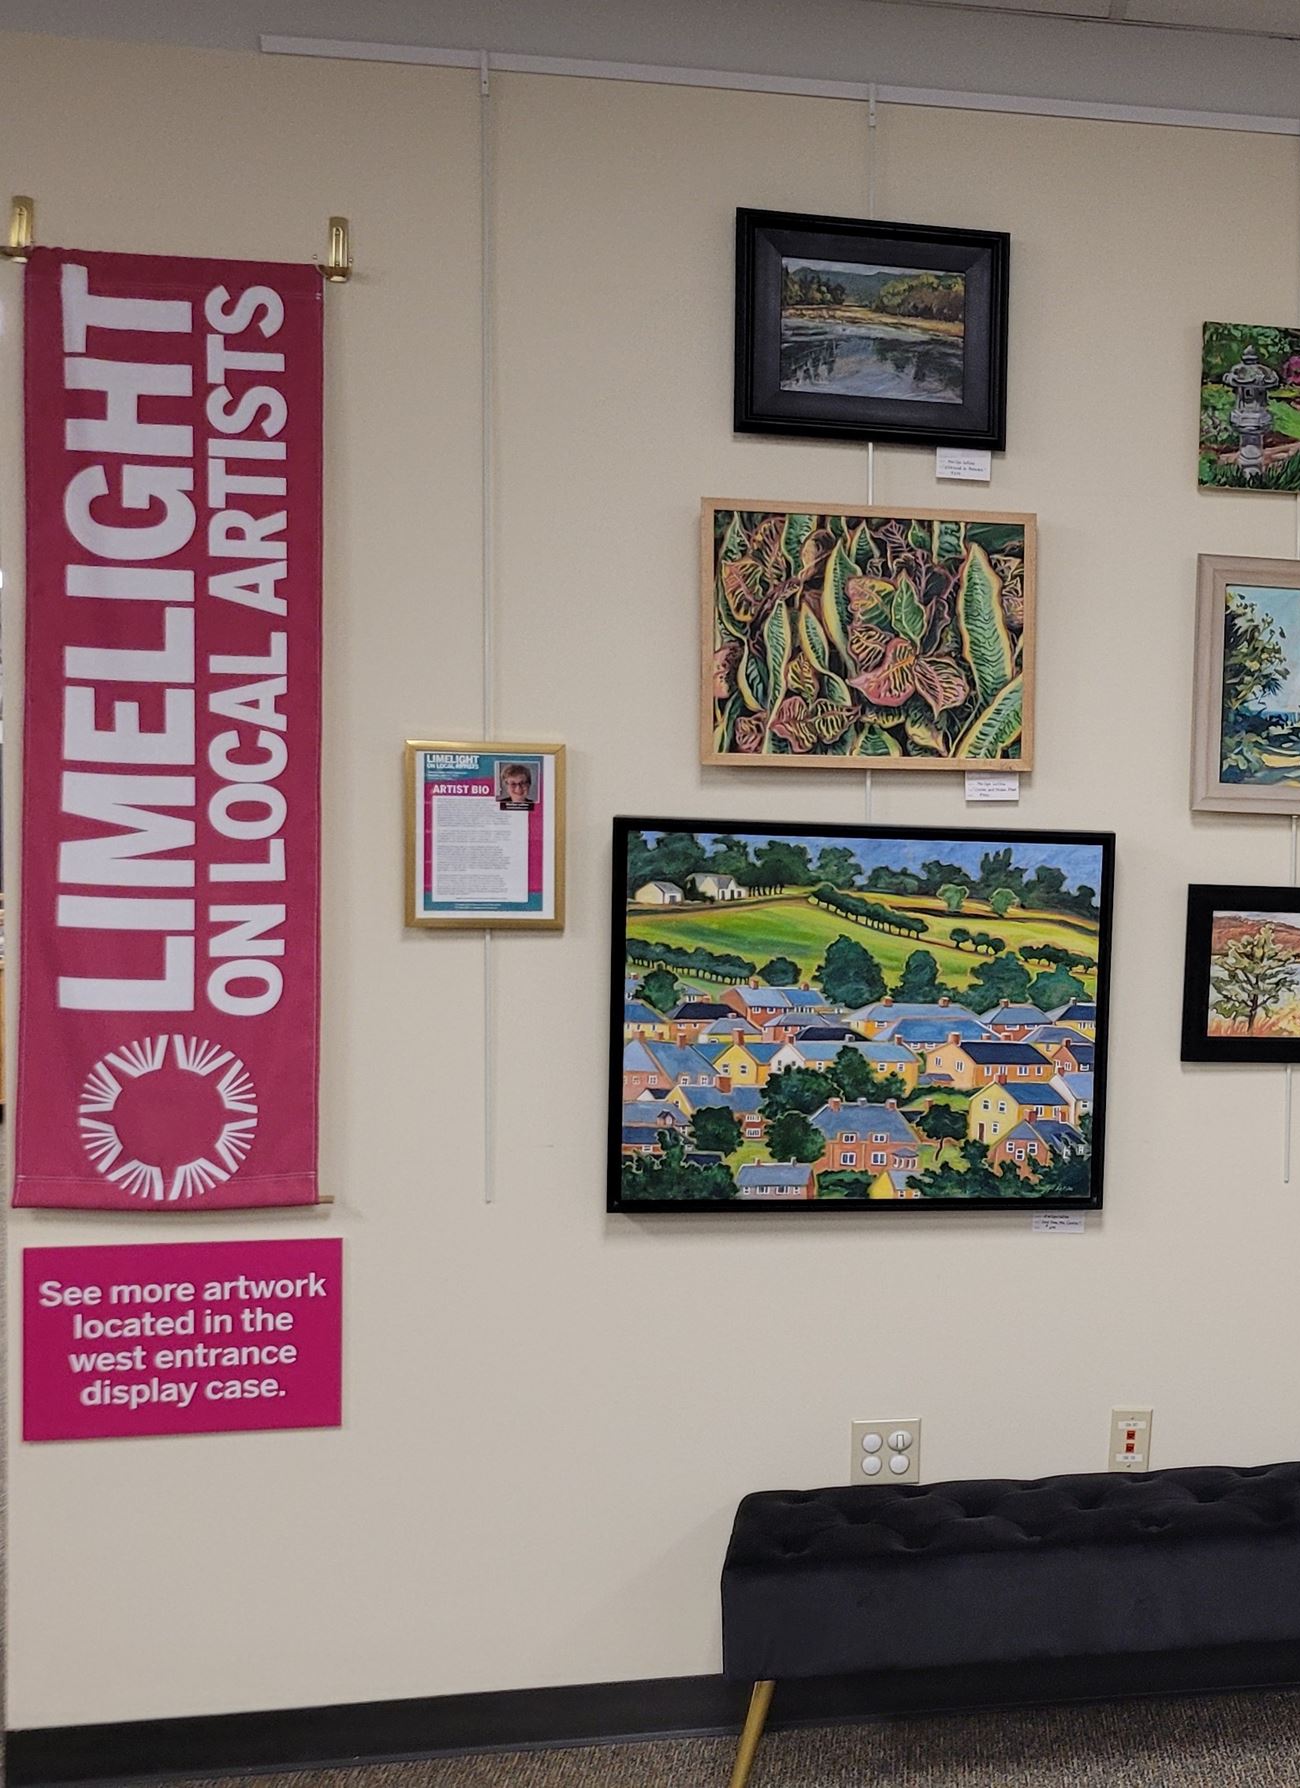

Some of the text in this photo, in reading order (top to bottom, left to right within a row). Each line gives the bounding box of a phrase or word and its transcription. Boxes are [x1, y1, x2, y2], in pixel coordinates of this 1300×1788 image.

[57, 263, 196, 1012] LIMELIGHT
[205, 285, 288, 1016] ON LOCAL ARTISTS
[426, 754, 480, 764] LIMELIGHT
[432, 784, 490, 794] ARTIST BIO
[39, 1272, 327, 1307] See more artwork
[72, 1307, 294, 1340] located in the
[68, 1343, 298, 1373] west entrance
[80, 1377, 287, 1410] display case.
